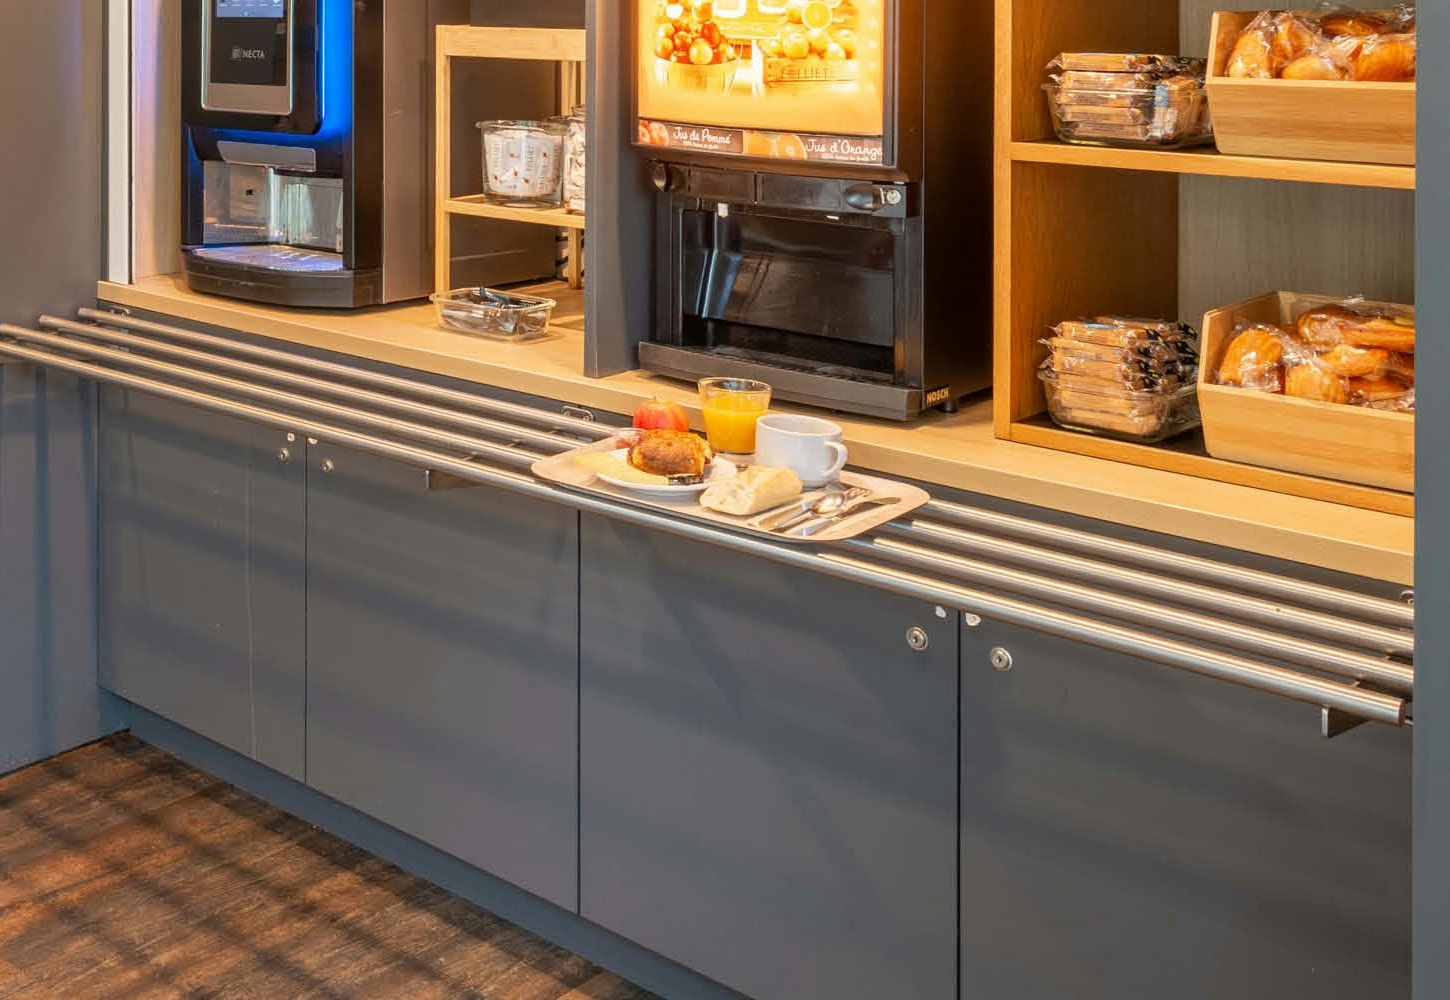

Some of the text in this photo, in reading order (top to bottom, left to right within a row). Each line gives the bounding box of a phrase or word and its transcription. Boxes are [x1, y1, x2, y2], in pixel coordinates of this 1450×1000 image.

[242, 49, 266, 60] NECTA
[673, 126, 688, 140] Jus
[805, 139, 826, 153] Jus
